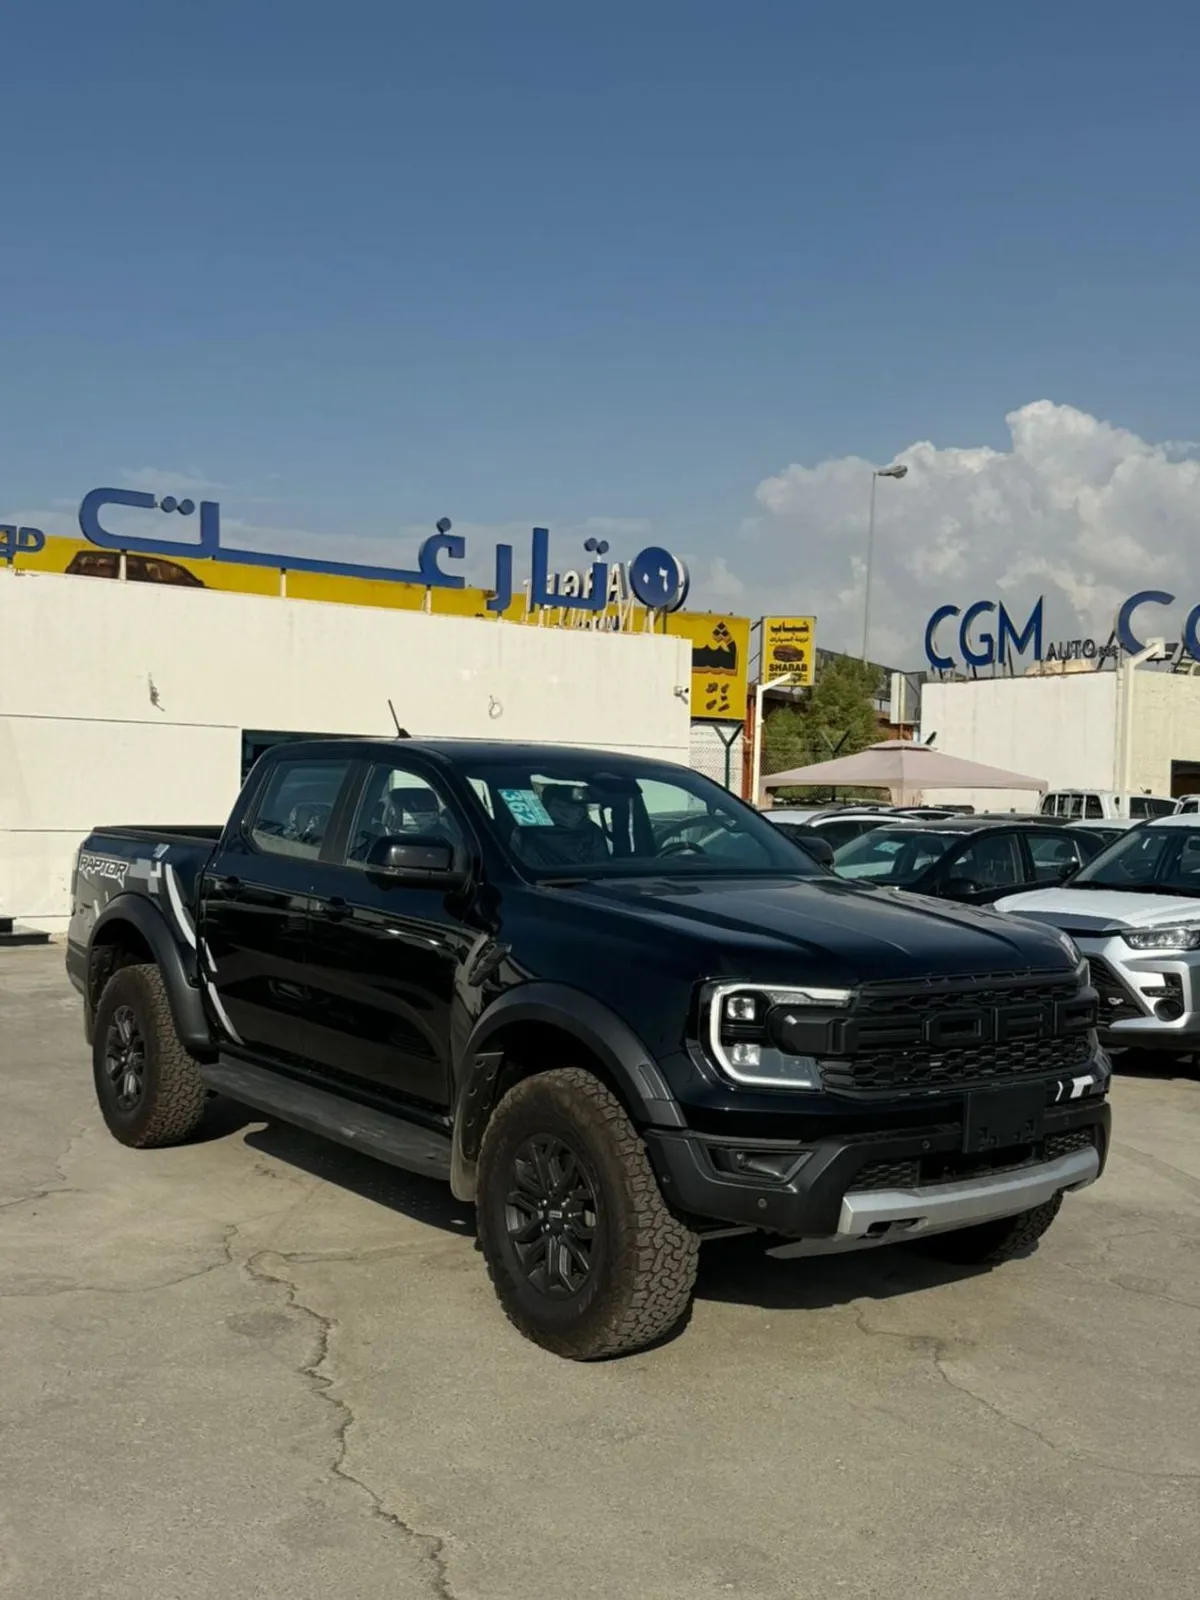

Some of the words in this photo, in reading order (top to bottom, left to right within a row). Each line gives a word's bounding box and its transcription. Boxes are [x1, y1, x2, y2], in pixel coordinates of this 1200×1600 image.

[924, 595, 1043, 669] CGM
[1046, 638, 1097, 661] AUTO
[79, 854, 129, 888] RAPTOR
